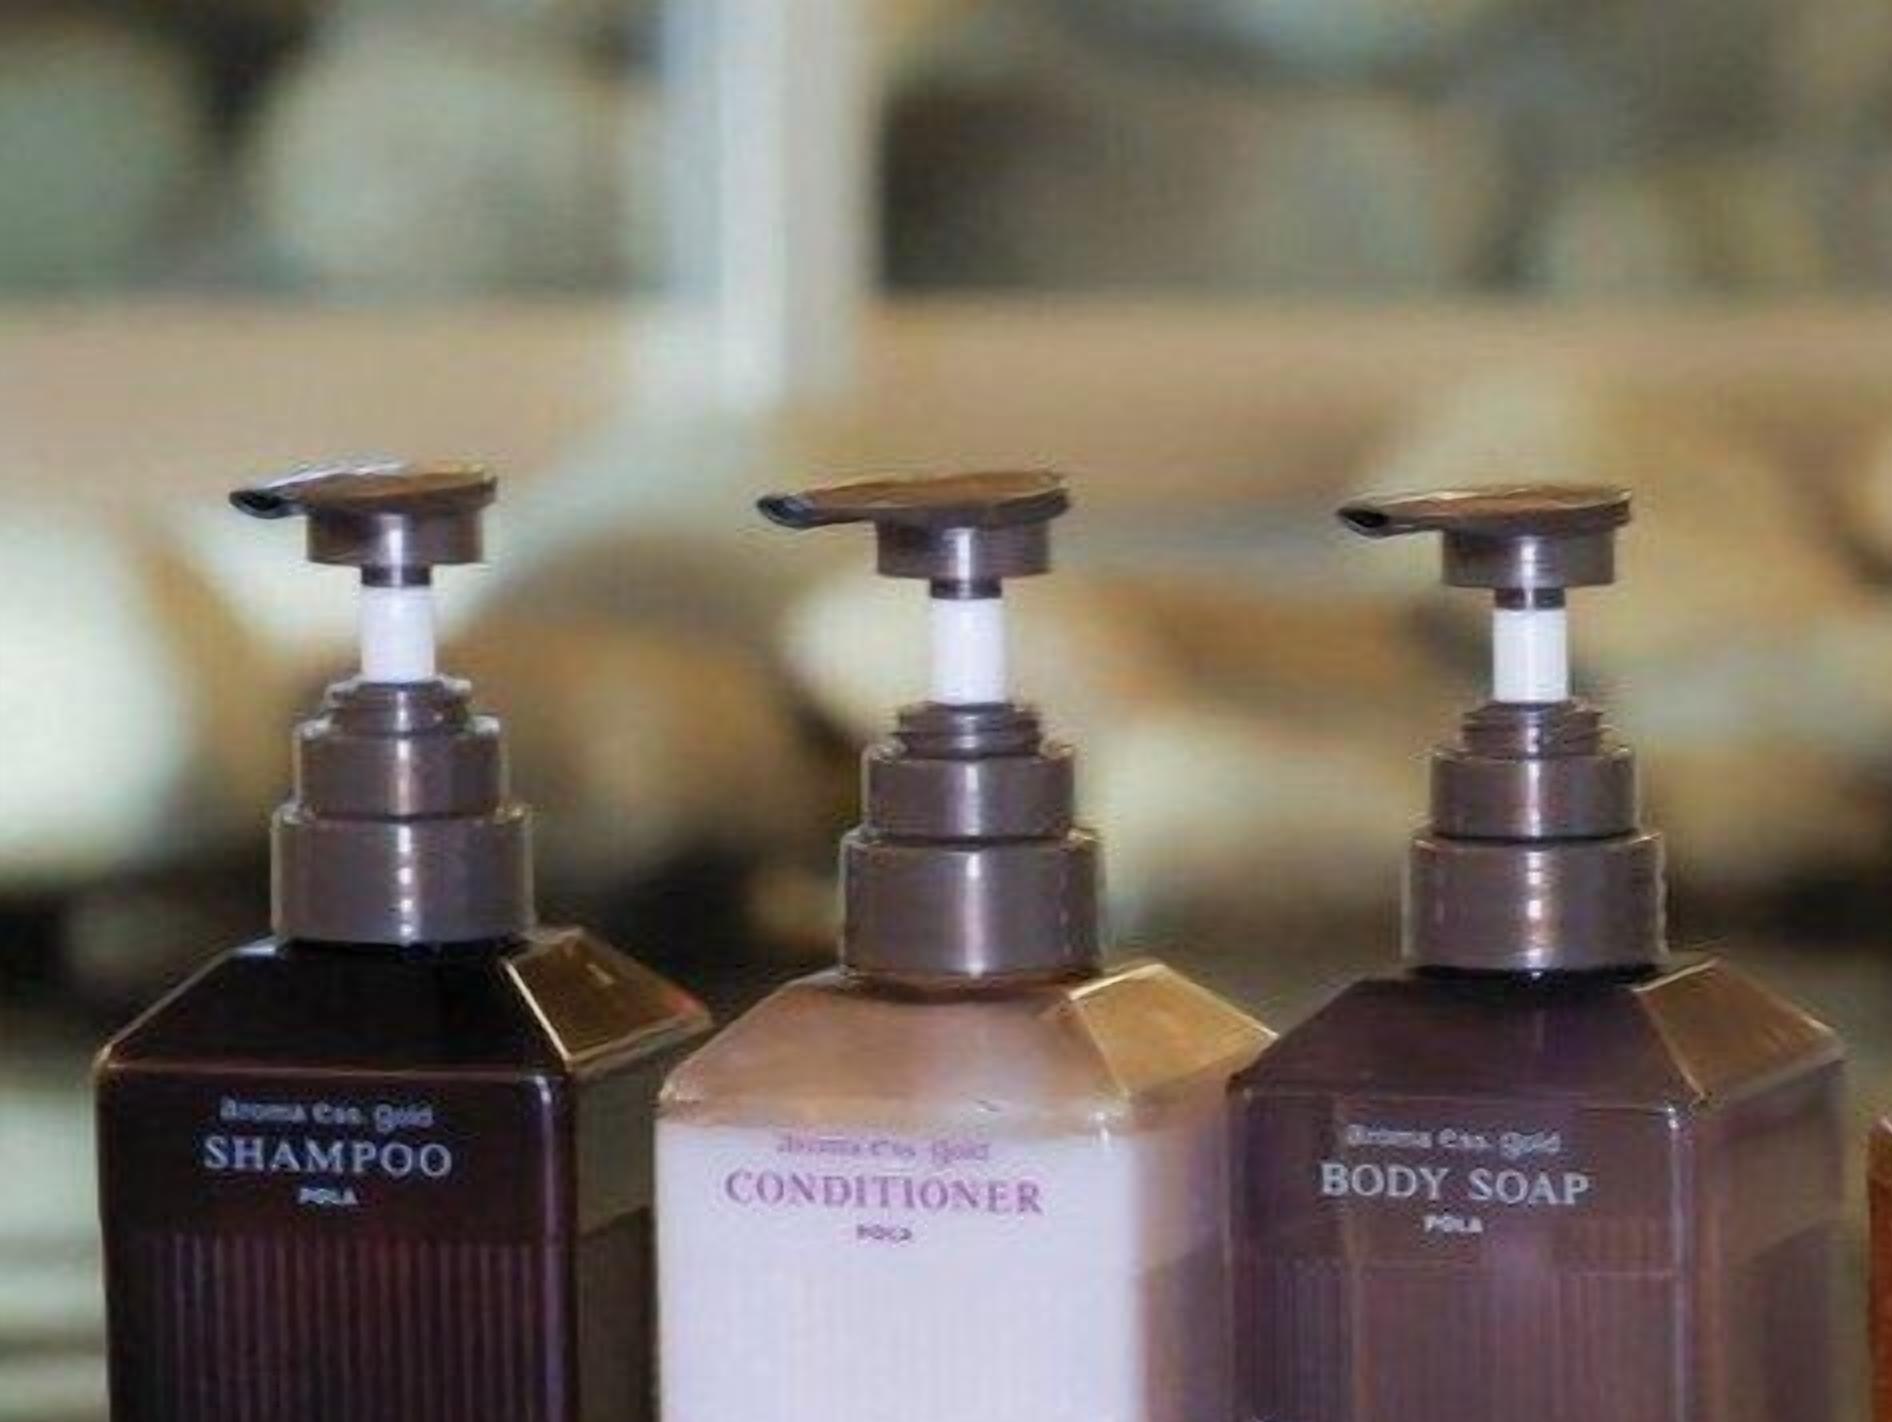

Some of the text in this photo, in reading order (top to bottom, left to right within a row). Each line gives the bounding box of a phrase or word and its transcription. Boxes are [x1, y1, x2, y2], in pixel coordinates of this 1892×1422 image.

[204, 1135, 452, 1178] SHAMPOO
[724, 1168, 1042, 1215] CONDITIONER
[1321, 1162, 1589, 1205] BODY SOAP
